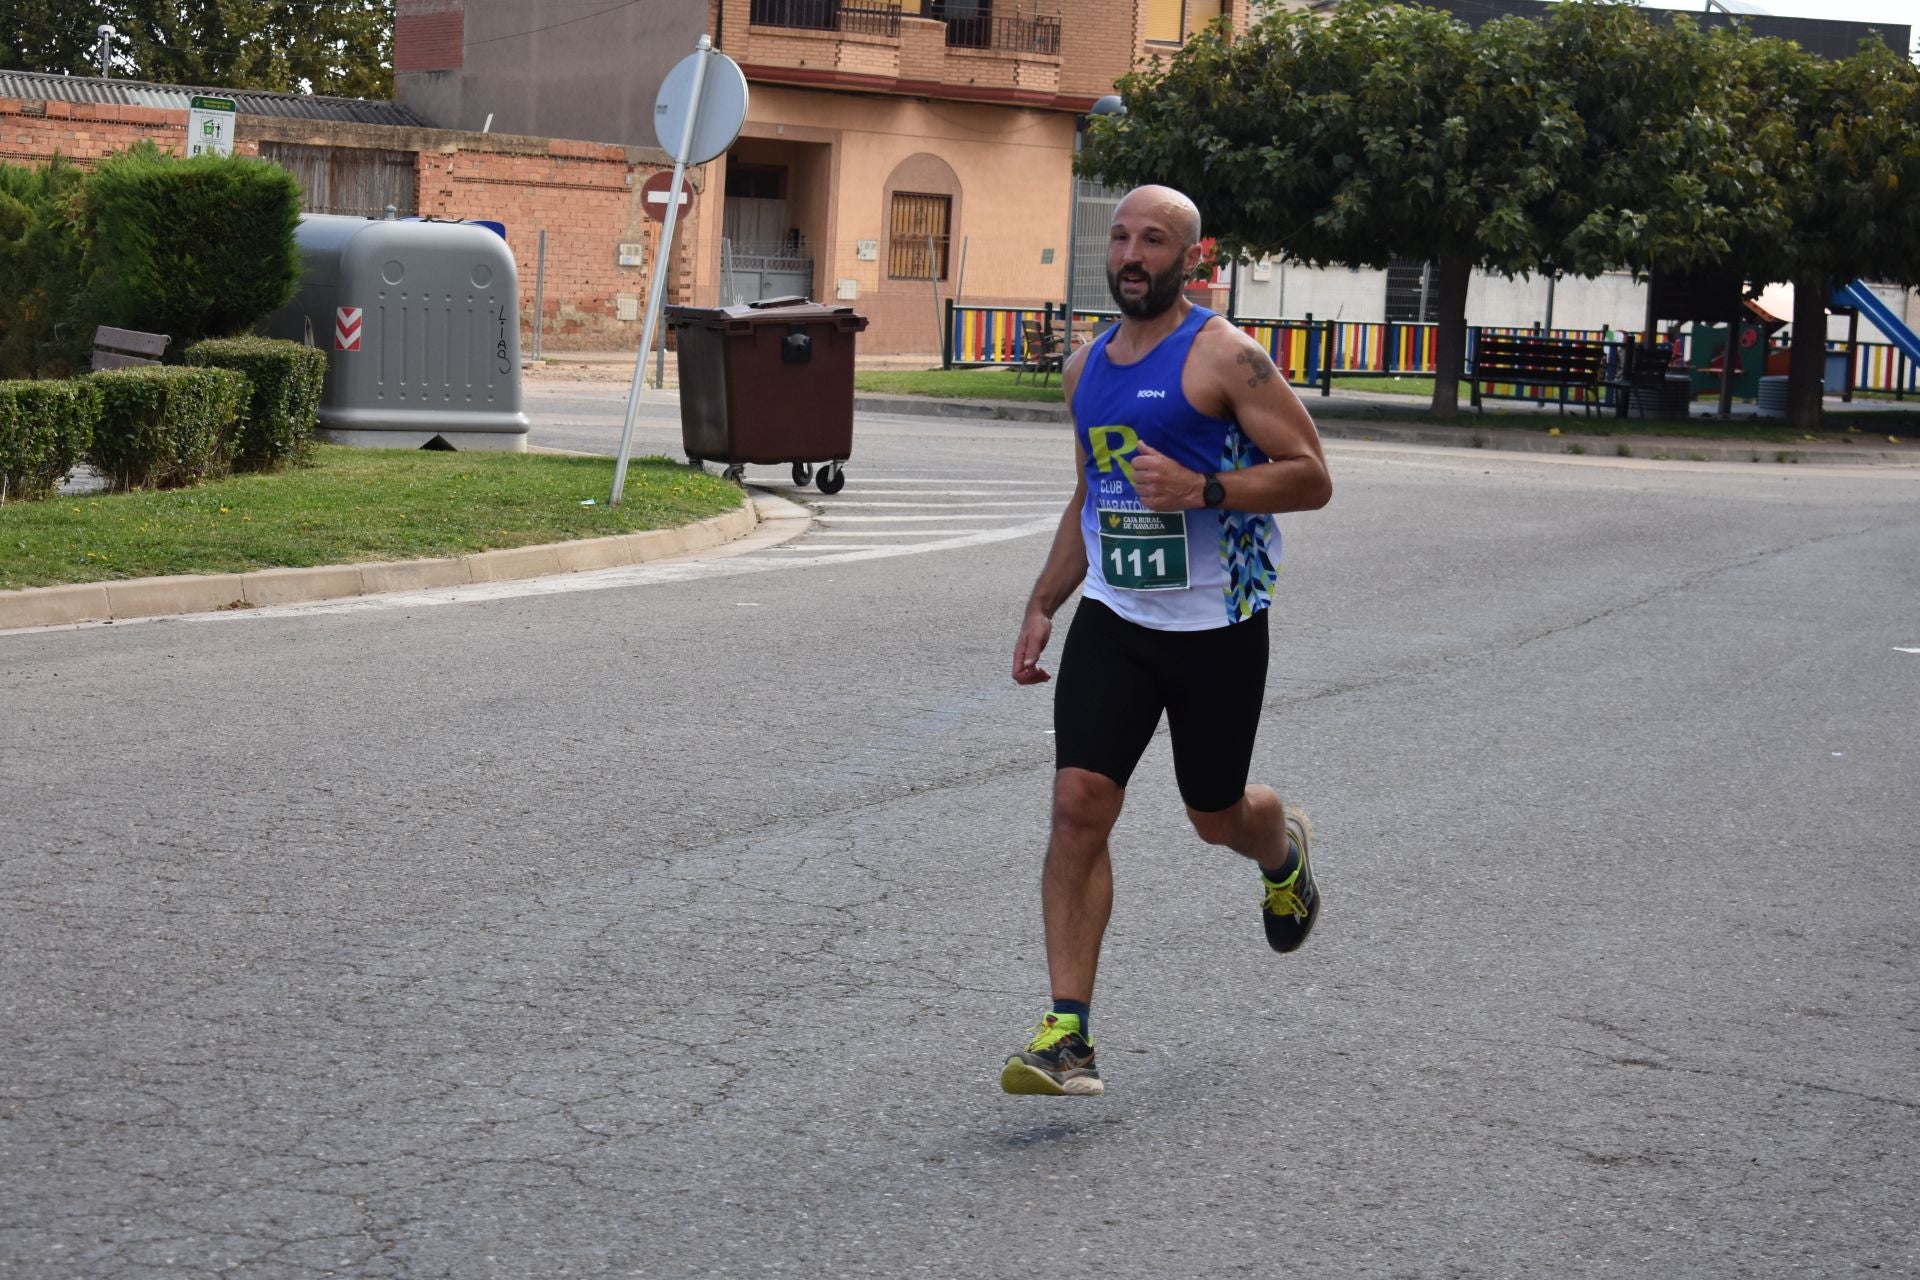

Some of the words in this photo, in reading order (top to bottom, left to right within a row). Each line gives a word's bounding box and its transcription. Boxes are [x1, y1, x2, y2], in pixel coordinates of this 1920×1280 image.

[1088, 425, 1138, 487] R
[1100, 480, 1123, 494] CLUB
[1099, 496, 1148, 510] MARATÓ
[1123, 516, 1138, 524] CAJA
[1110, 547, 1166, 577] 111
